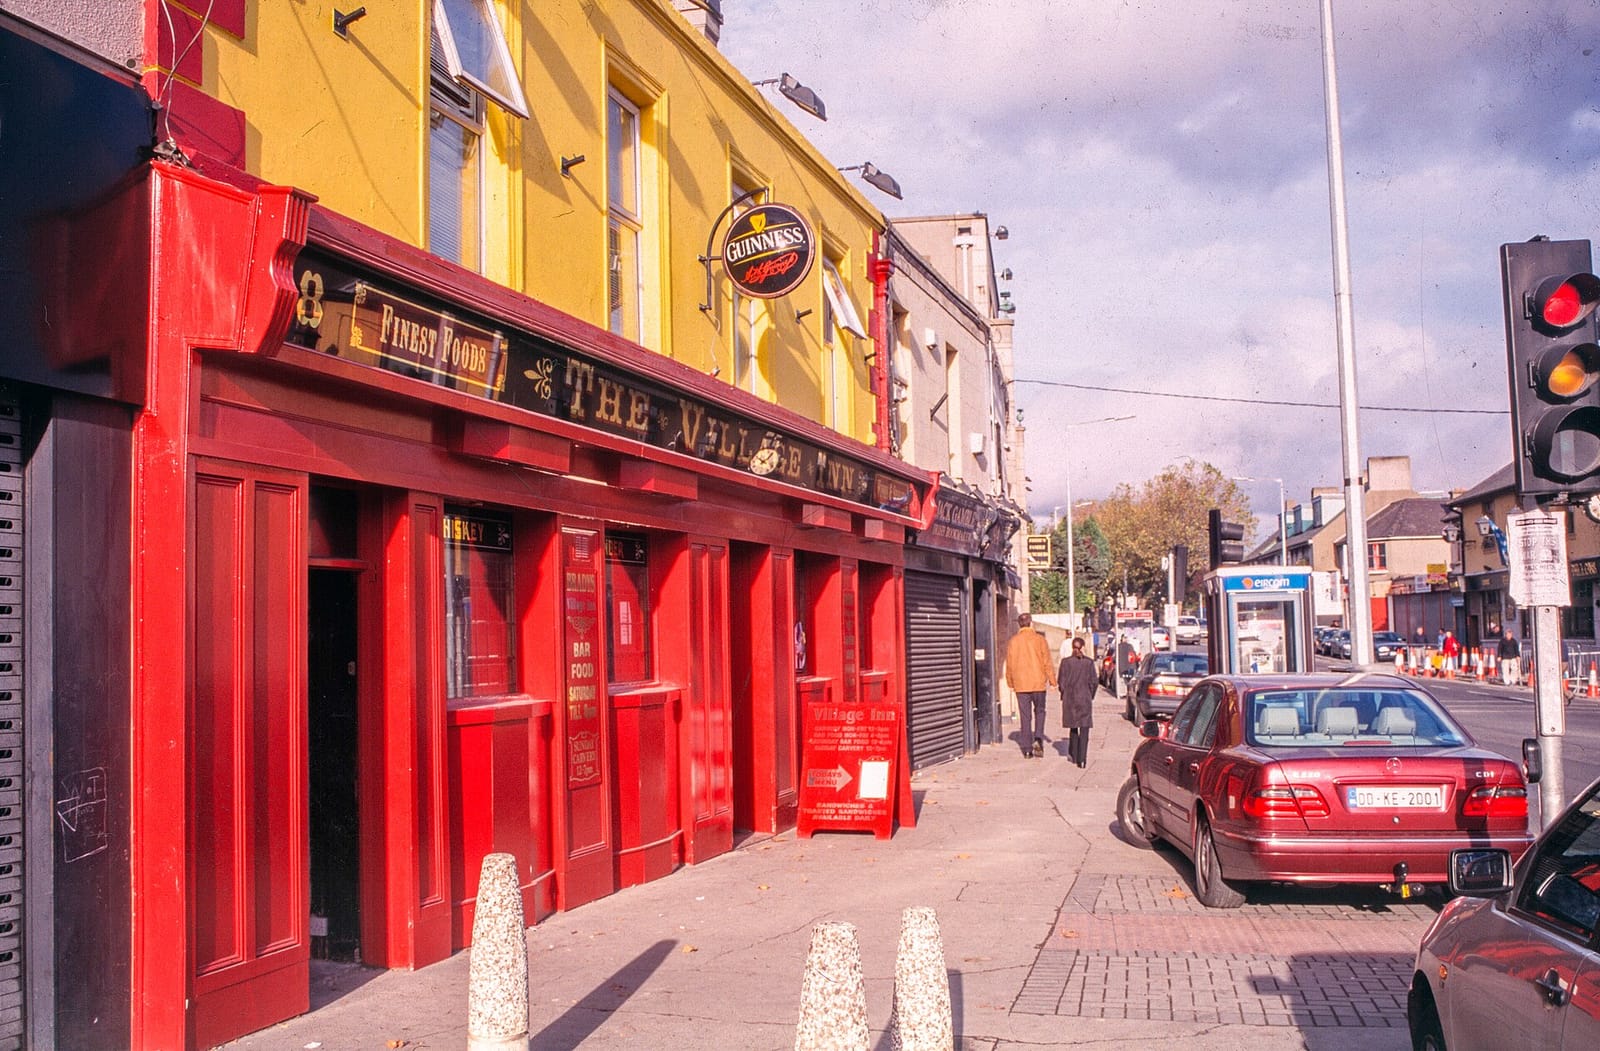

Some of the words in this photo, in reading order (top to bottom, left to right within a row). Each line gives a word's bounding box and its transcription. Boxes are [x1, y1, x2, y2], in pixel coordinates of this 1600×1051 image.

[296, 270, 324, 328] 8
[564, 356, 650, 431] THE
[816, 450, 855, 493] INN
[1254, 578, 1290, 588] eircom
[573, 642, 591, 658] BAR
[571, 663, 594, 679] FOOD
[813, 708, 864, 724] Village
[870, 708, 895, 721] Inn
